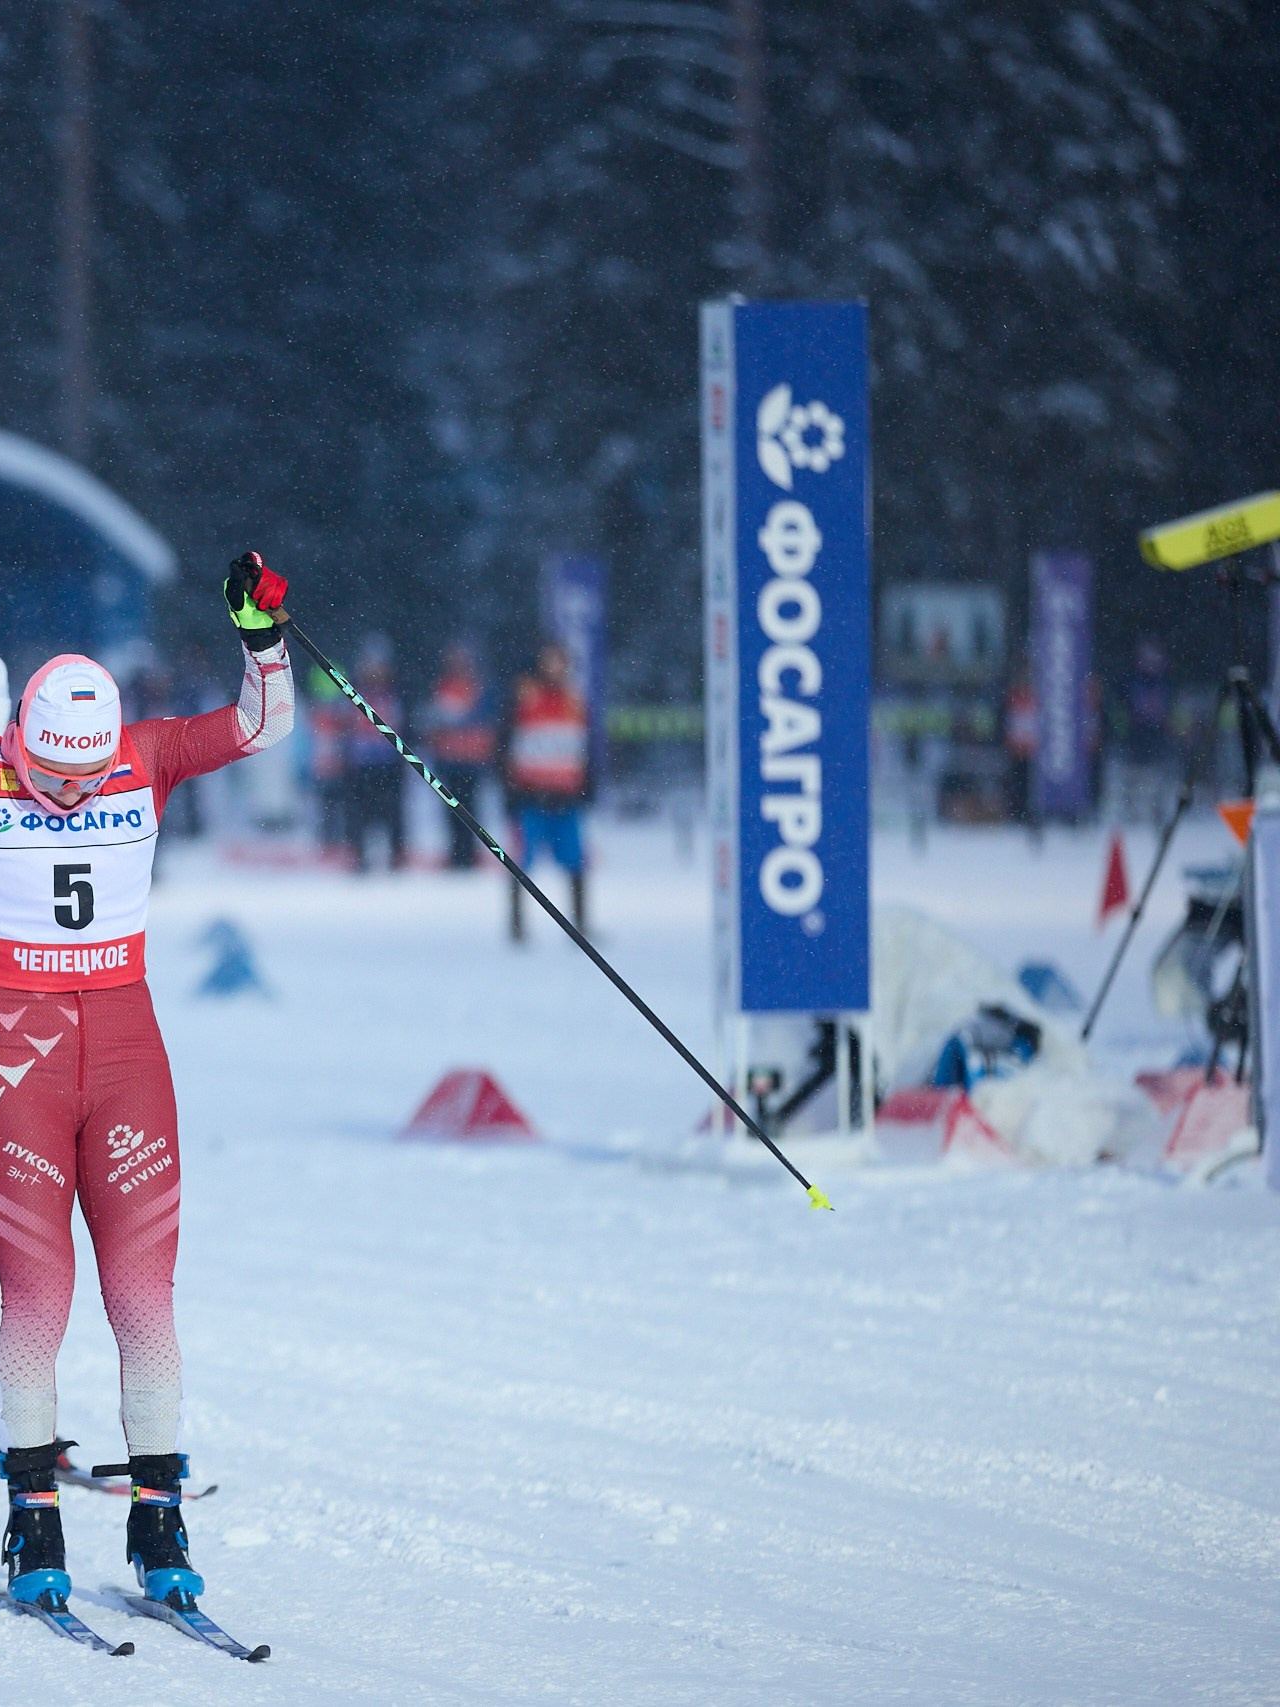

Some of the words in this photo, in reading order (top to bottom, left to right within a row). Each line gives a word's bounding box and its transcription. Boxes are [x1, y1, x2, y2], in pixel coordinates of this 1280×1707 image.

[757, 501, 822, 917] ФОСАГРО
[39, 730, 112, 750] ЛУКОЙЛ
[20, 809, 142, 831] ФОСАГРО
[54, 864, 94, 930] 5
[14, 943, 128, 975] ЧЕПЕЦКОЕ
[2, 1141, 66, 1188] ЛУКОЙЛ
[107, 1137, 167, 1183] ФОСАГРО
[120, 1154, 173, 1194] BIVIUM
[140, 1493, 171, 1503] SALOMON
